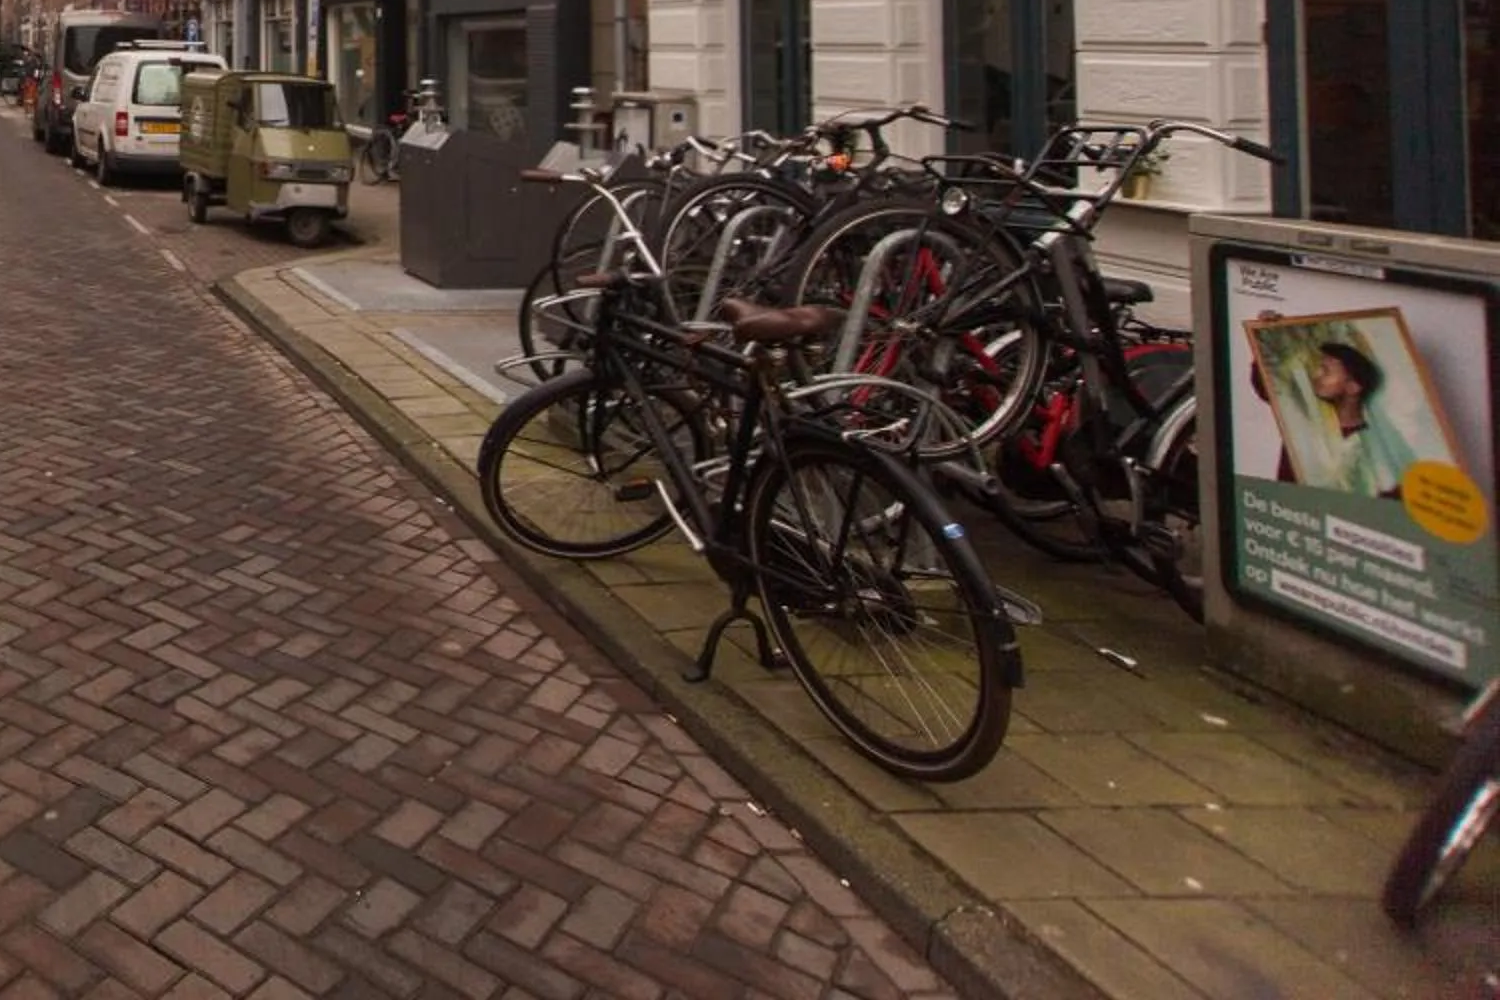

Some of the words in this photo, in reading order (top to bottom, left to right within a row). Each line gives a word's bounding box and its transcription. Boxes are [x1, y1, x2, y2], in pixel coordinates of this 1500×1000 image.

[1243, 490, 1268, 513] De
[1271, 500, 1321, 532] beste
[1243, 518, 1284, 539] voor
